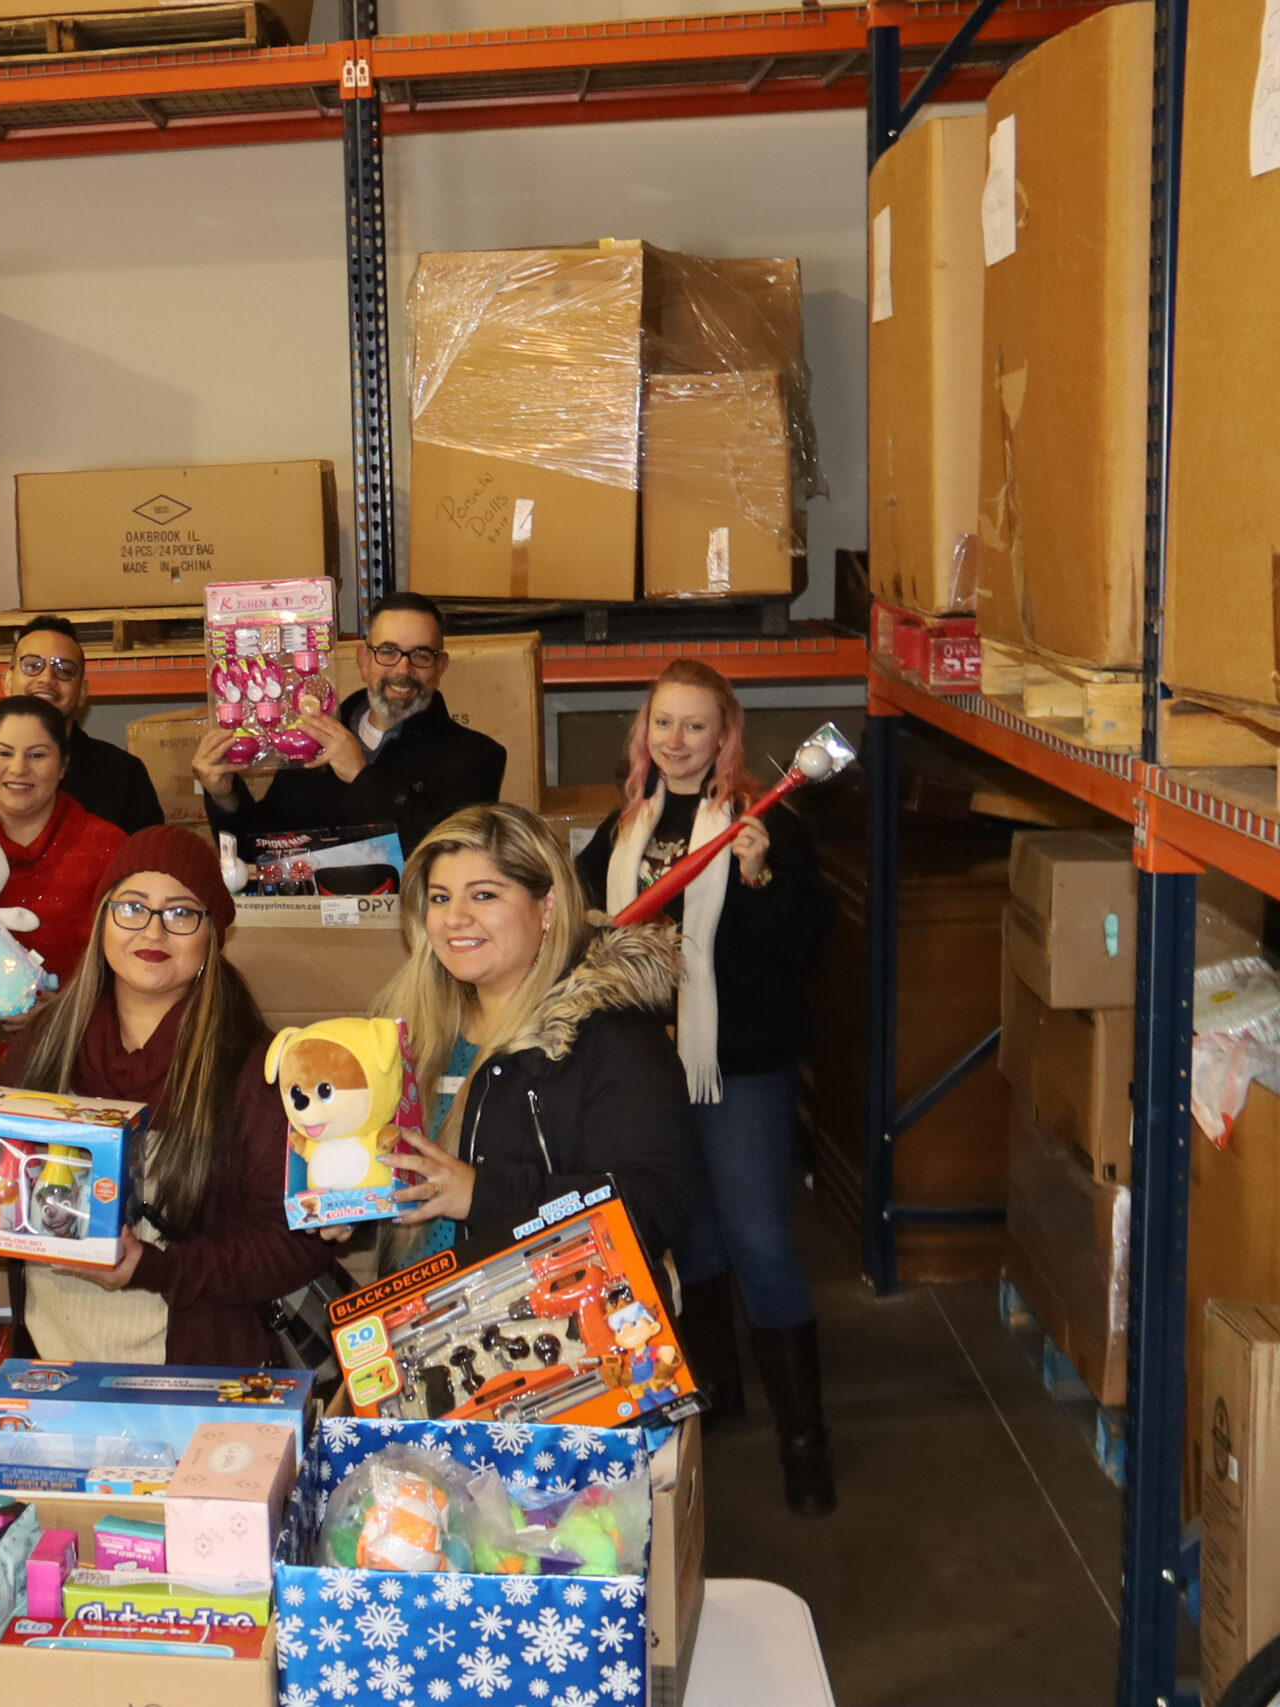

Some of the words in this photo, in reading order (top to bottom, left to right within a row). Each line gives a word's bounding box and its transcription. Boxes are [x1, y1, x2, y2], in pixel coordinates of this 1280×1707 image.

[126, 530, 181, 542] OAKBROOK
[121, 545, 133, 557] 24
[173, 544, 194, 556] POLY
[196, 543, 215, 555] BAG
[123, 561, 149, 573] MADE
[160, 561, 170, 572] IN
[180, 560, 212, 572] CHINA
[357, 898, 395, 913] OPY
[538, 1191, 580, 1216] JUNIOR
[513, 1217, 545, 1240] FUN
[543, 1199, 586, 1225] TOOL
[584, 1185, 612, 1207] SET
[336, 1256, 451, 1319] BLACK+DECKER
[346, 1326, 375, 1349] 20
[83, 1624, 139, 1634] Dinosaur
[140, 1626, 169, 1636] Play
[170, 1627, 191, 1636] Set
